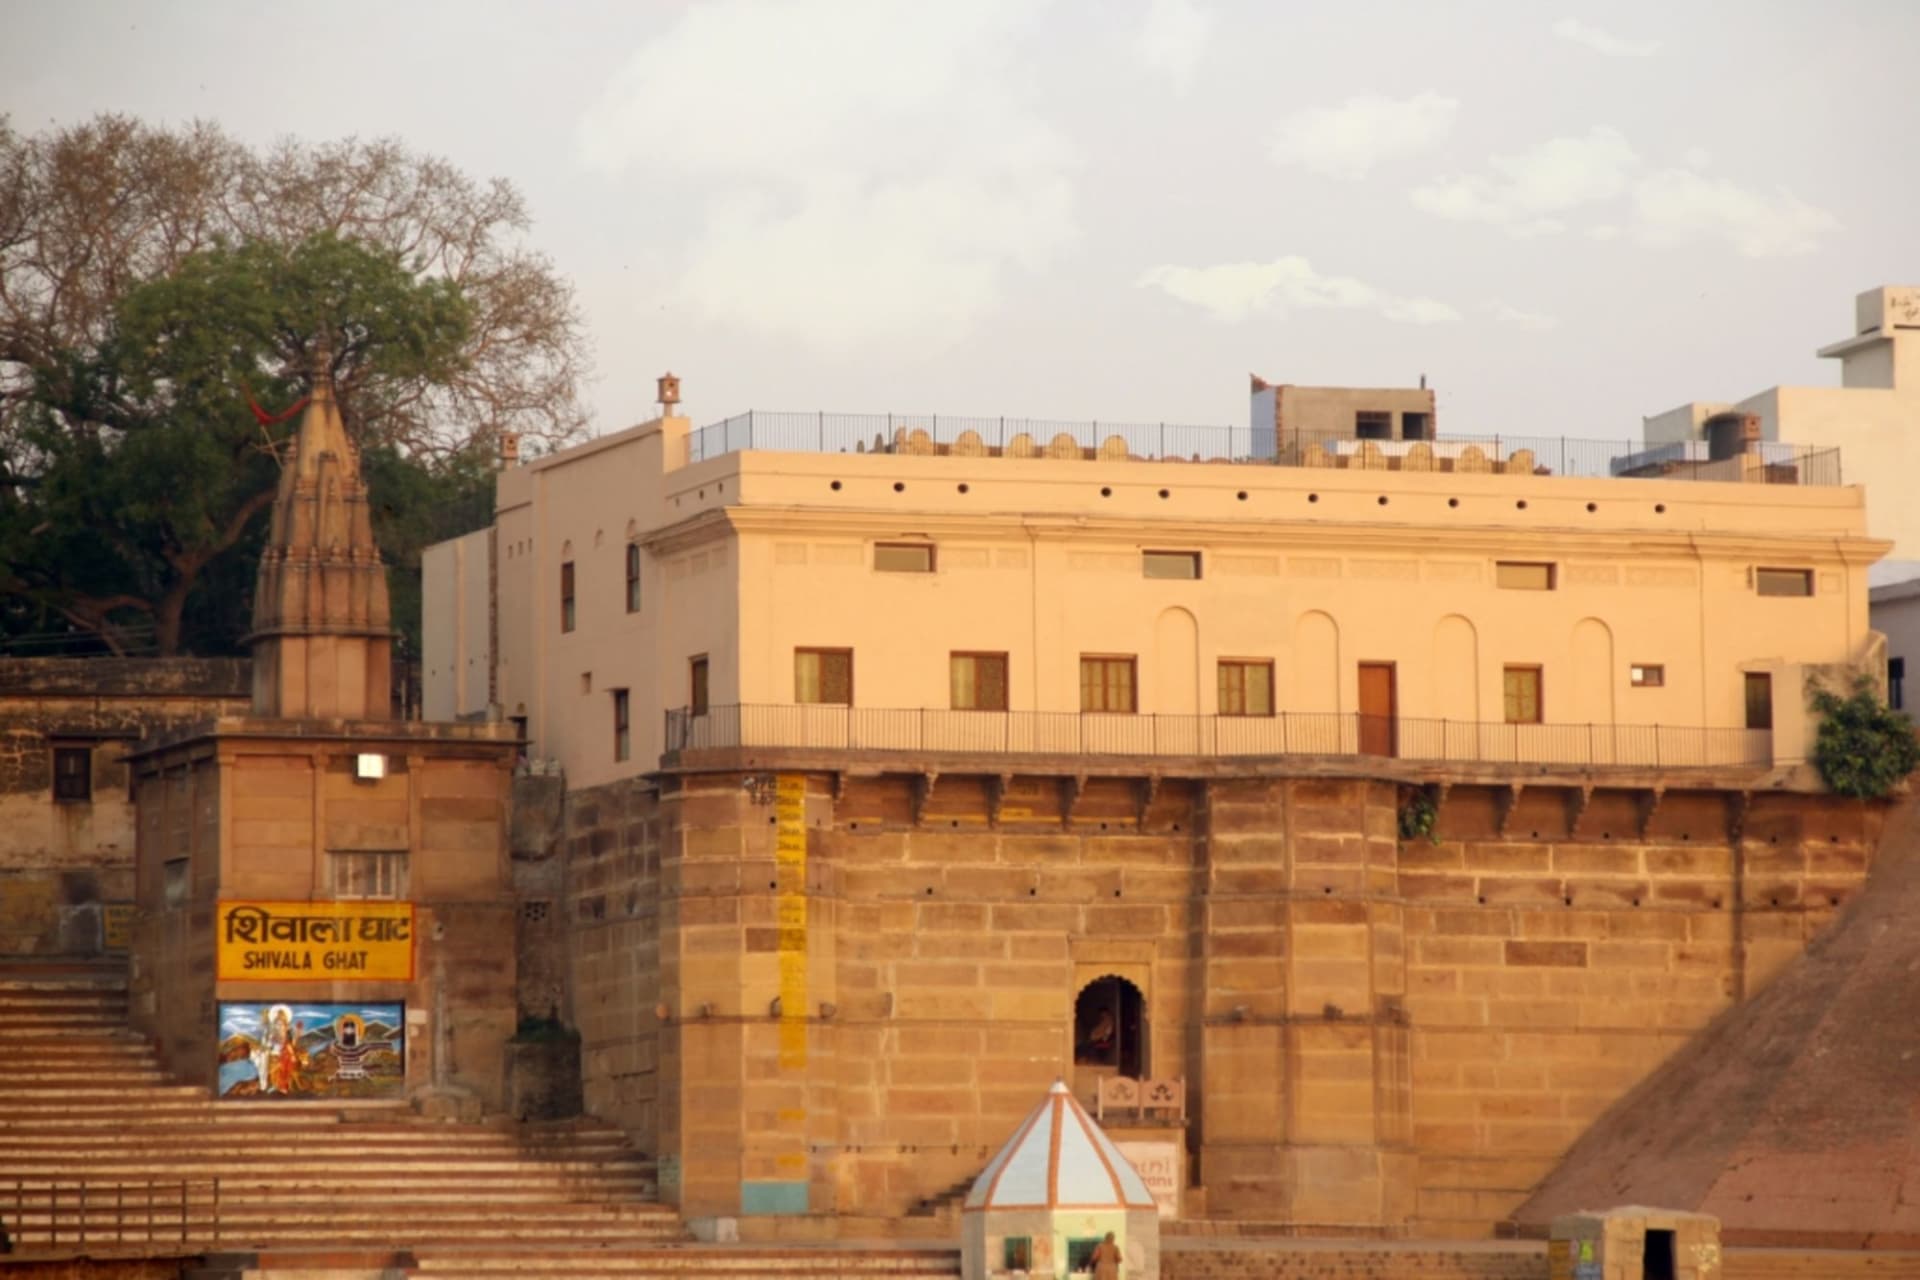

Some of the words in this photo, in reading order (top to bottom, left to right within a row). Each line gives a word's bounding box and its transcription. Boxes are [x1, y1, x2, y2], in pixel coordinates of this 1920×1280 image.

[225, 905, 353, 943] शिवाला
[358, 917, 411, 941] घाट
[243, 951, 312, 970] SHIVALA
[322, 951, 368, 970] GHAT
